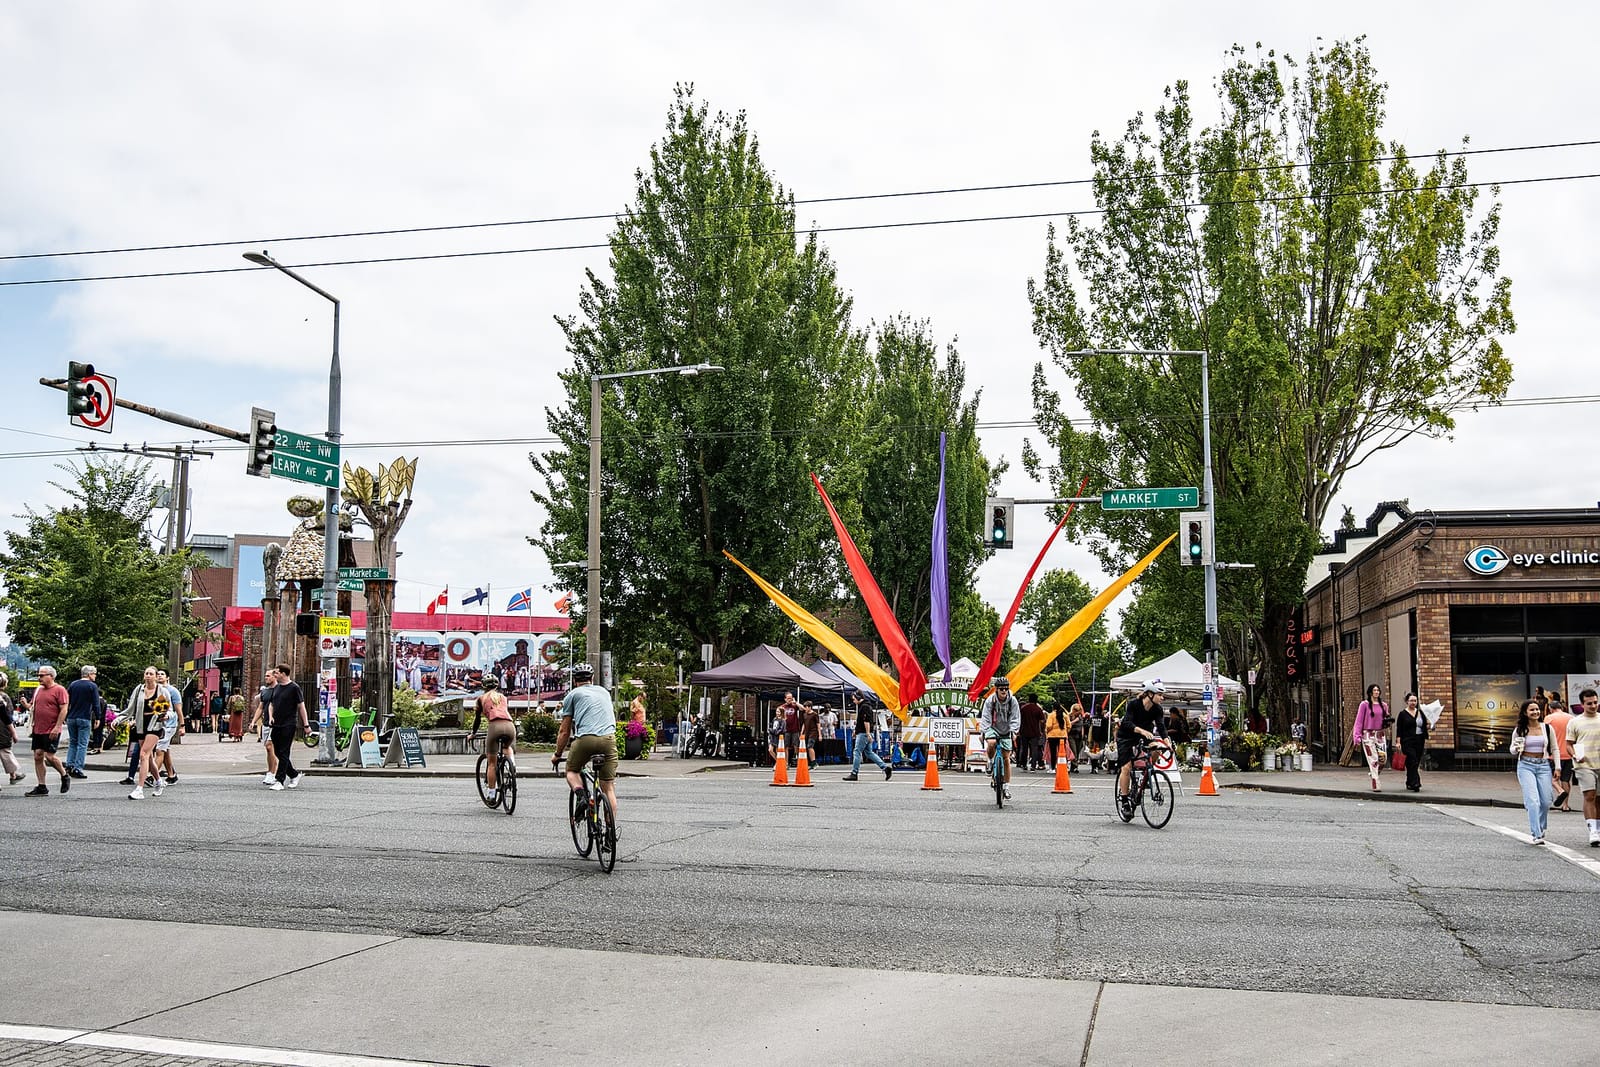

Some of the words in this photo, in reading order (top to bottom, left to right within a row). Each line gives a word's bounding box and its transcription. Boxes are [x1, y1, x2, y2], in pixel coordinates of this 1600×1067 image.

[275, 433, 288, 447] 22
[295, 439, 312, 453] AVE
[317, 445, 332, 458] NW
[272, 456, 301, 474] LEARY
[305, 466, 317, 477] AVE
[1110, 493, 1158, 504] MARKET
[1512, 553, 1545, 567] eye
[1549, 550, 1600, 564] clinic
[349, 569, 371, 578] Market
[323, 620, 348, 628] TURNING
[1464, 701, 1520, 710] ALOHA
[934, 721, 960, 730] STREET
[933, 730, 961, 739] CLOSED
